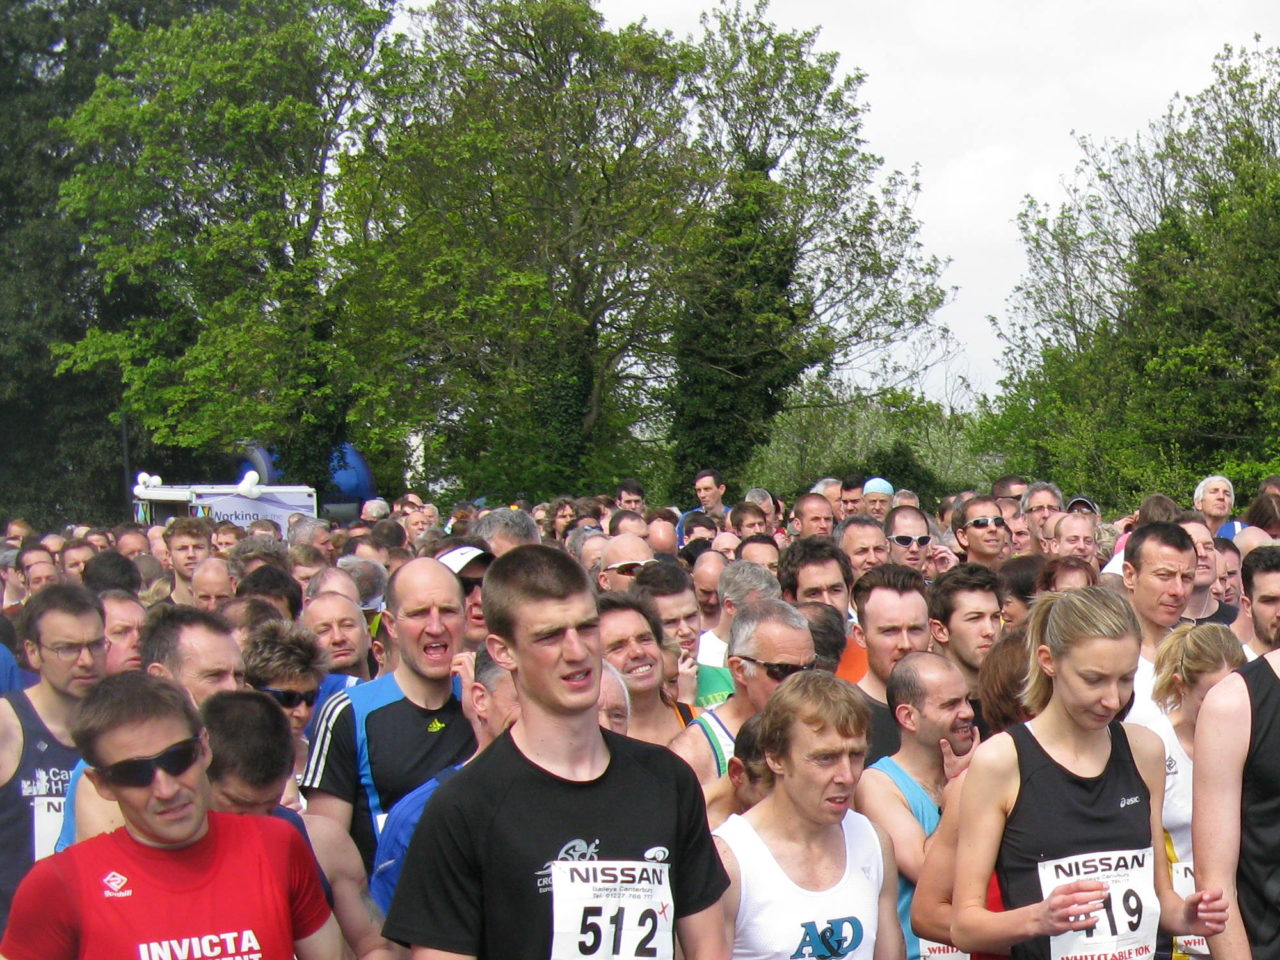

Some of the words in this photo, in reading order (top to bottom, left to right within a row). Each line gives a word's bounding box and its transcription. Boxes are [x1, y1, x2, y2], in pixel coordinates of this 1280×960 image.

[569, 866, 663, 886] NISSAN
[1054, 853, 1146, 880] NISSAN
[577, 906, 657, 958] 512
[1134, 944, 1151, 958] 10K
